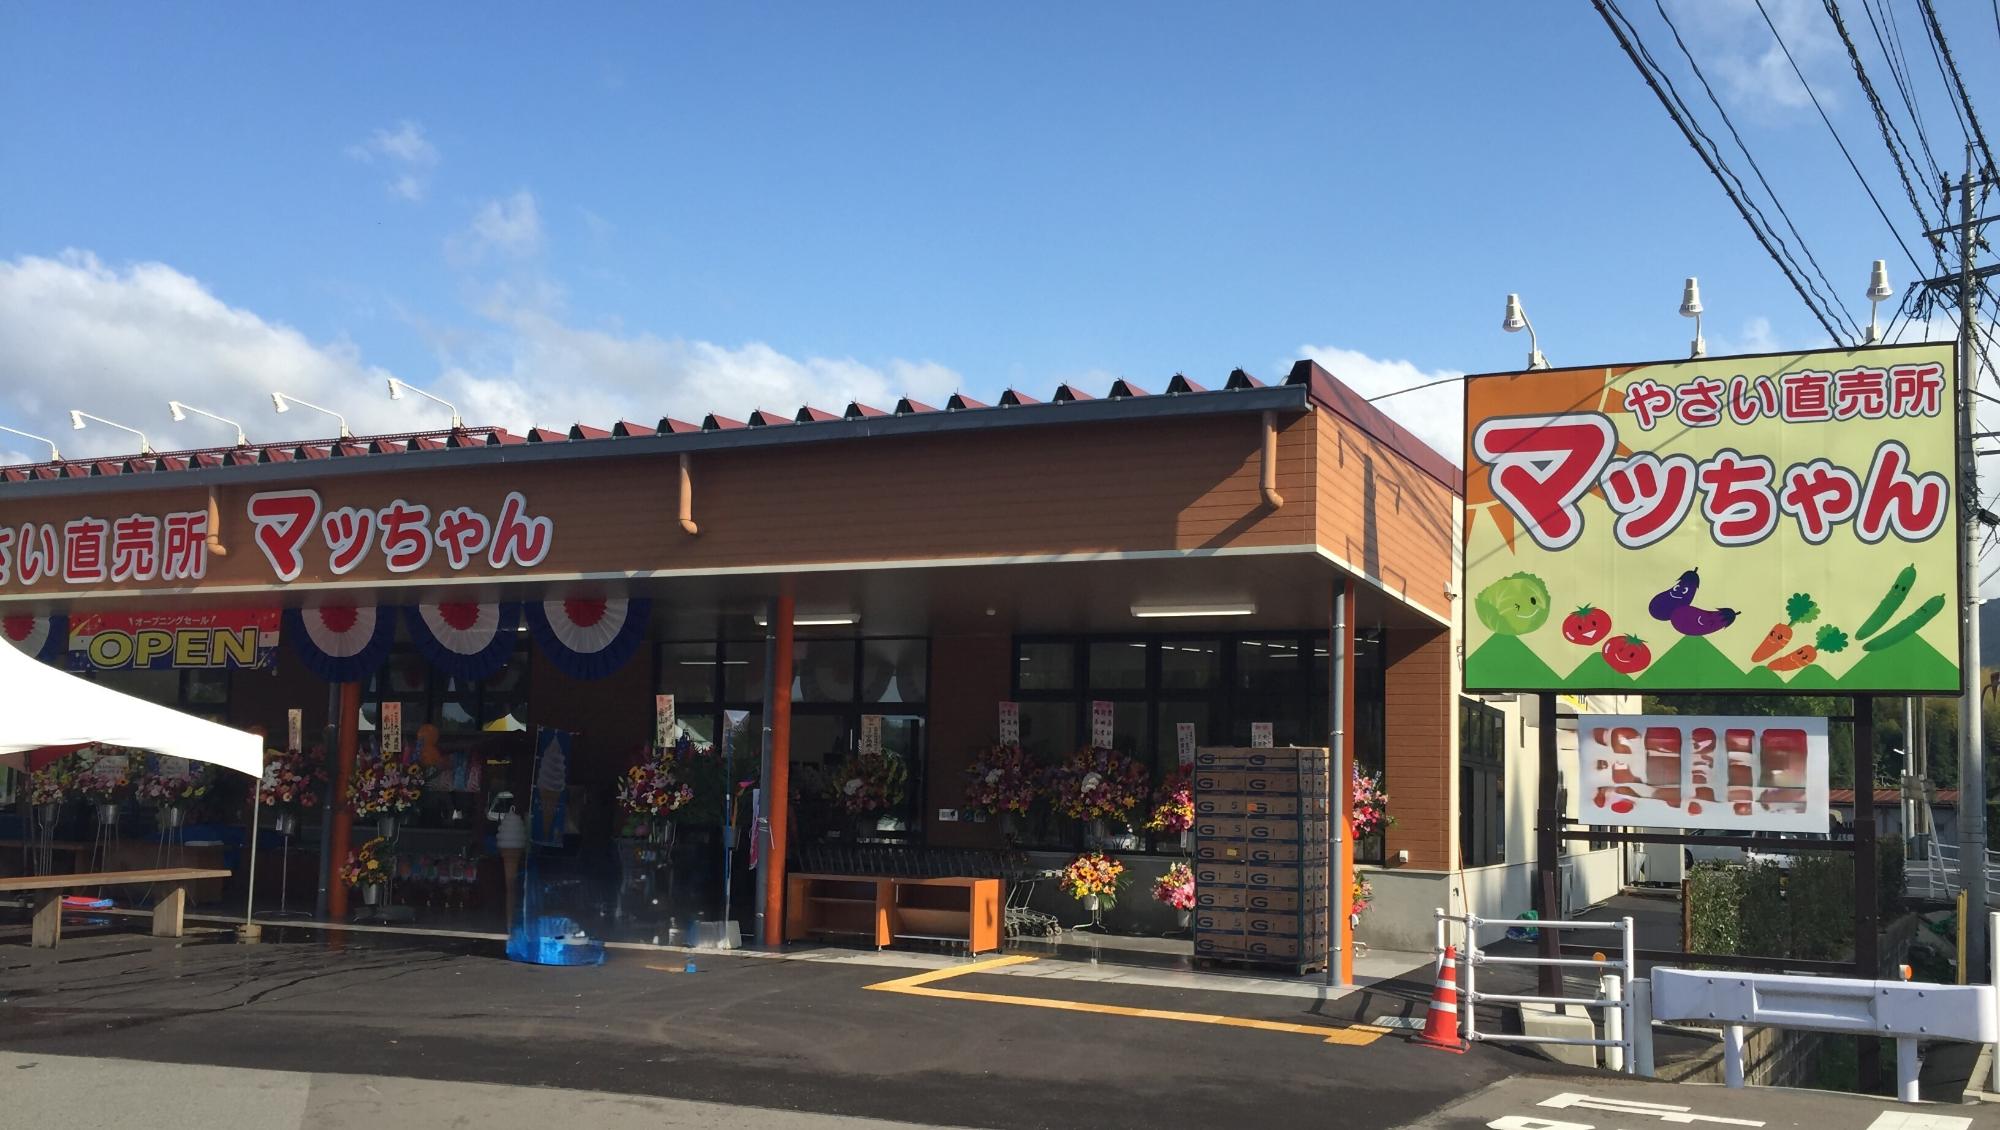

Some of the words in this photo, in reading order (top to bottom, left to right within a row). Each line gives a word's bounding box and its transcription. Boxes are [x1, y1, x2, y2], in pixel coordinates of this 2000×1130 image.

[1624, 362, 1945, 431] やさい直売所
[87, 626, 259, 669] OPEN
